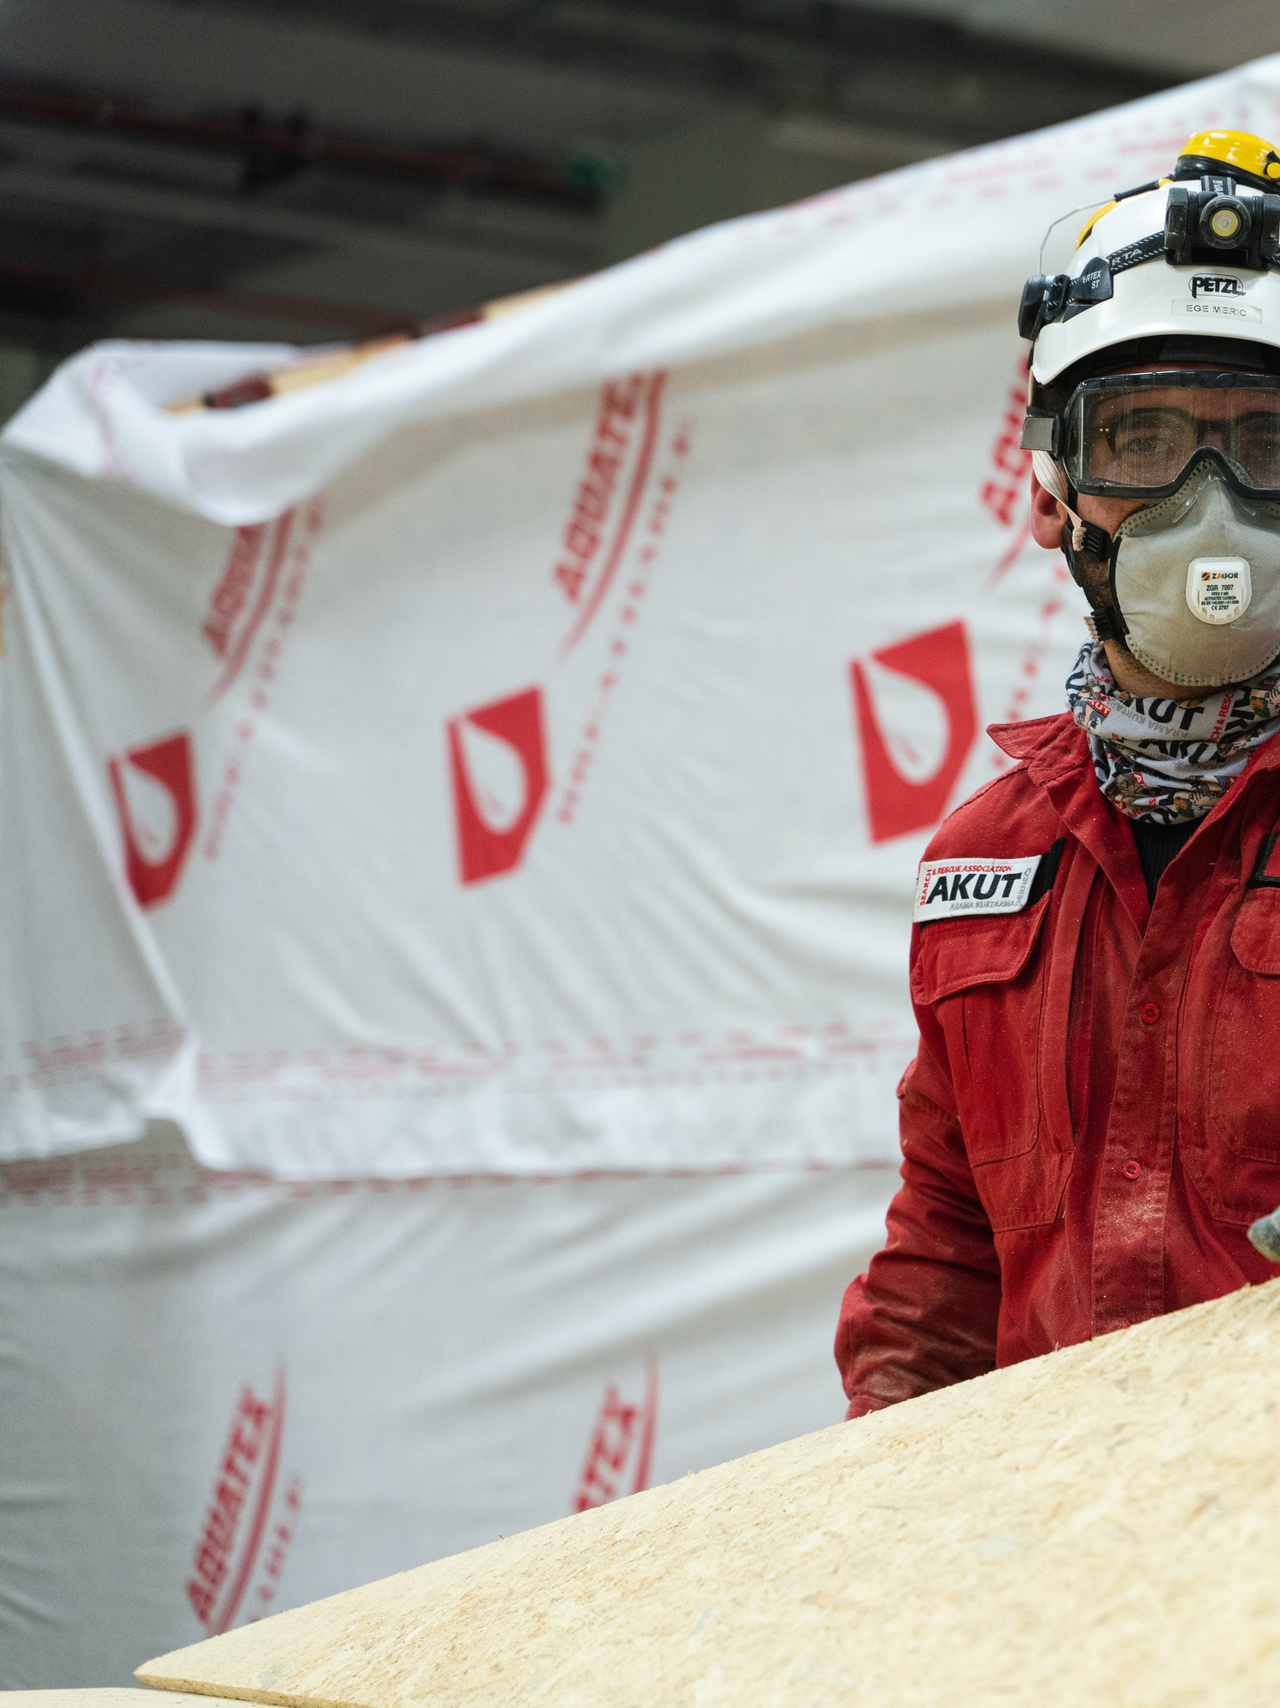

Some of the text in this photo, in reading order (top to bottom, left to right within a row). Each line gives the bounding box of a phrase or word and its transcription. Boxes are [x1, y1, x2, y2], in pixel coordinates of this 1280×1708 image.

[1192, 277, 1246, 299] PETZL
[1186, 304, 1247, 317] EGE MERIC
[936, 865, 962, 875] RESCUE
[963, 864, 1013, 873] ASSOCIATION
[919, 868, 933, 906] SEARCH
[925, 872, 1023, 905] AKUT
